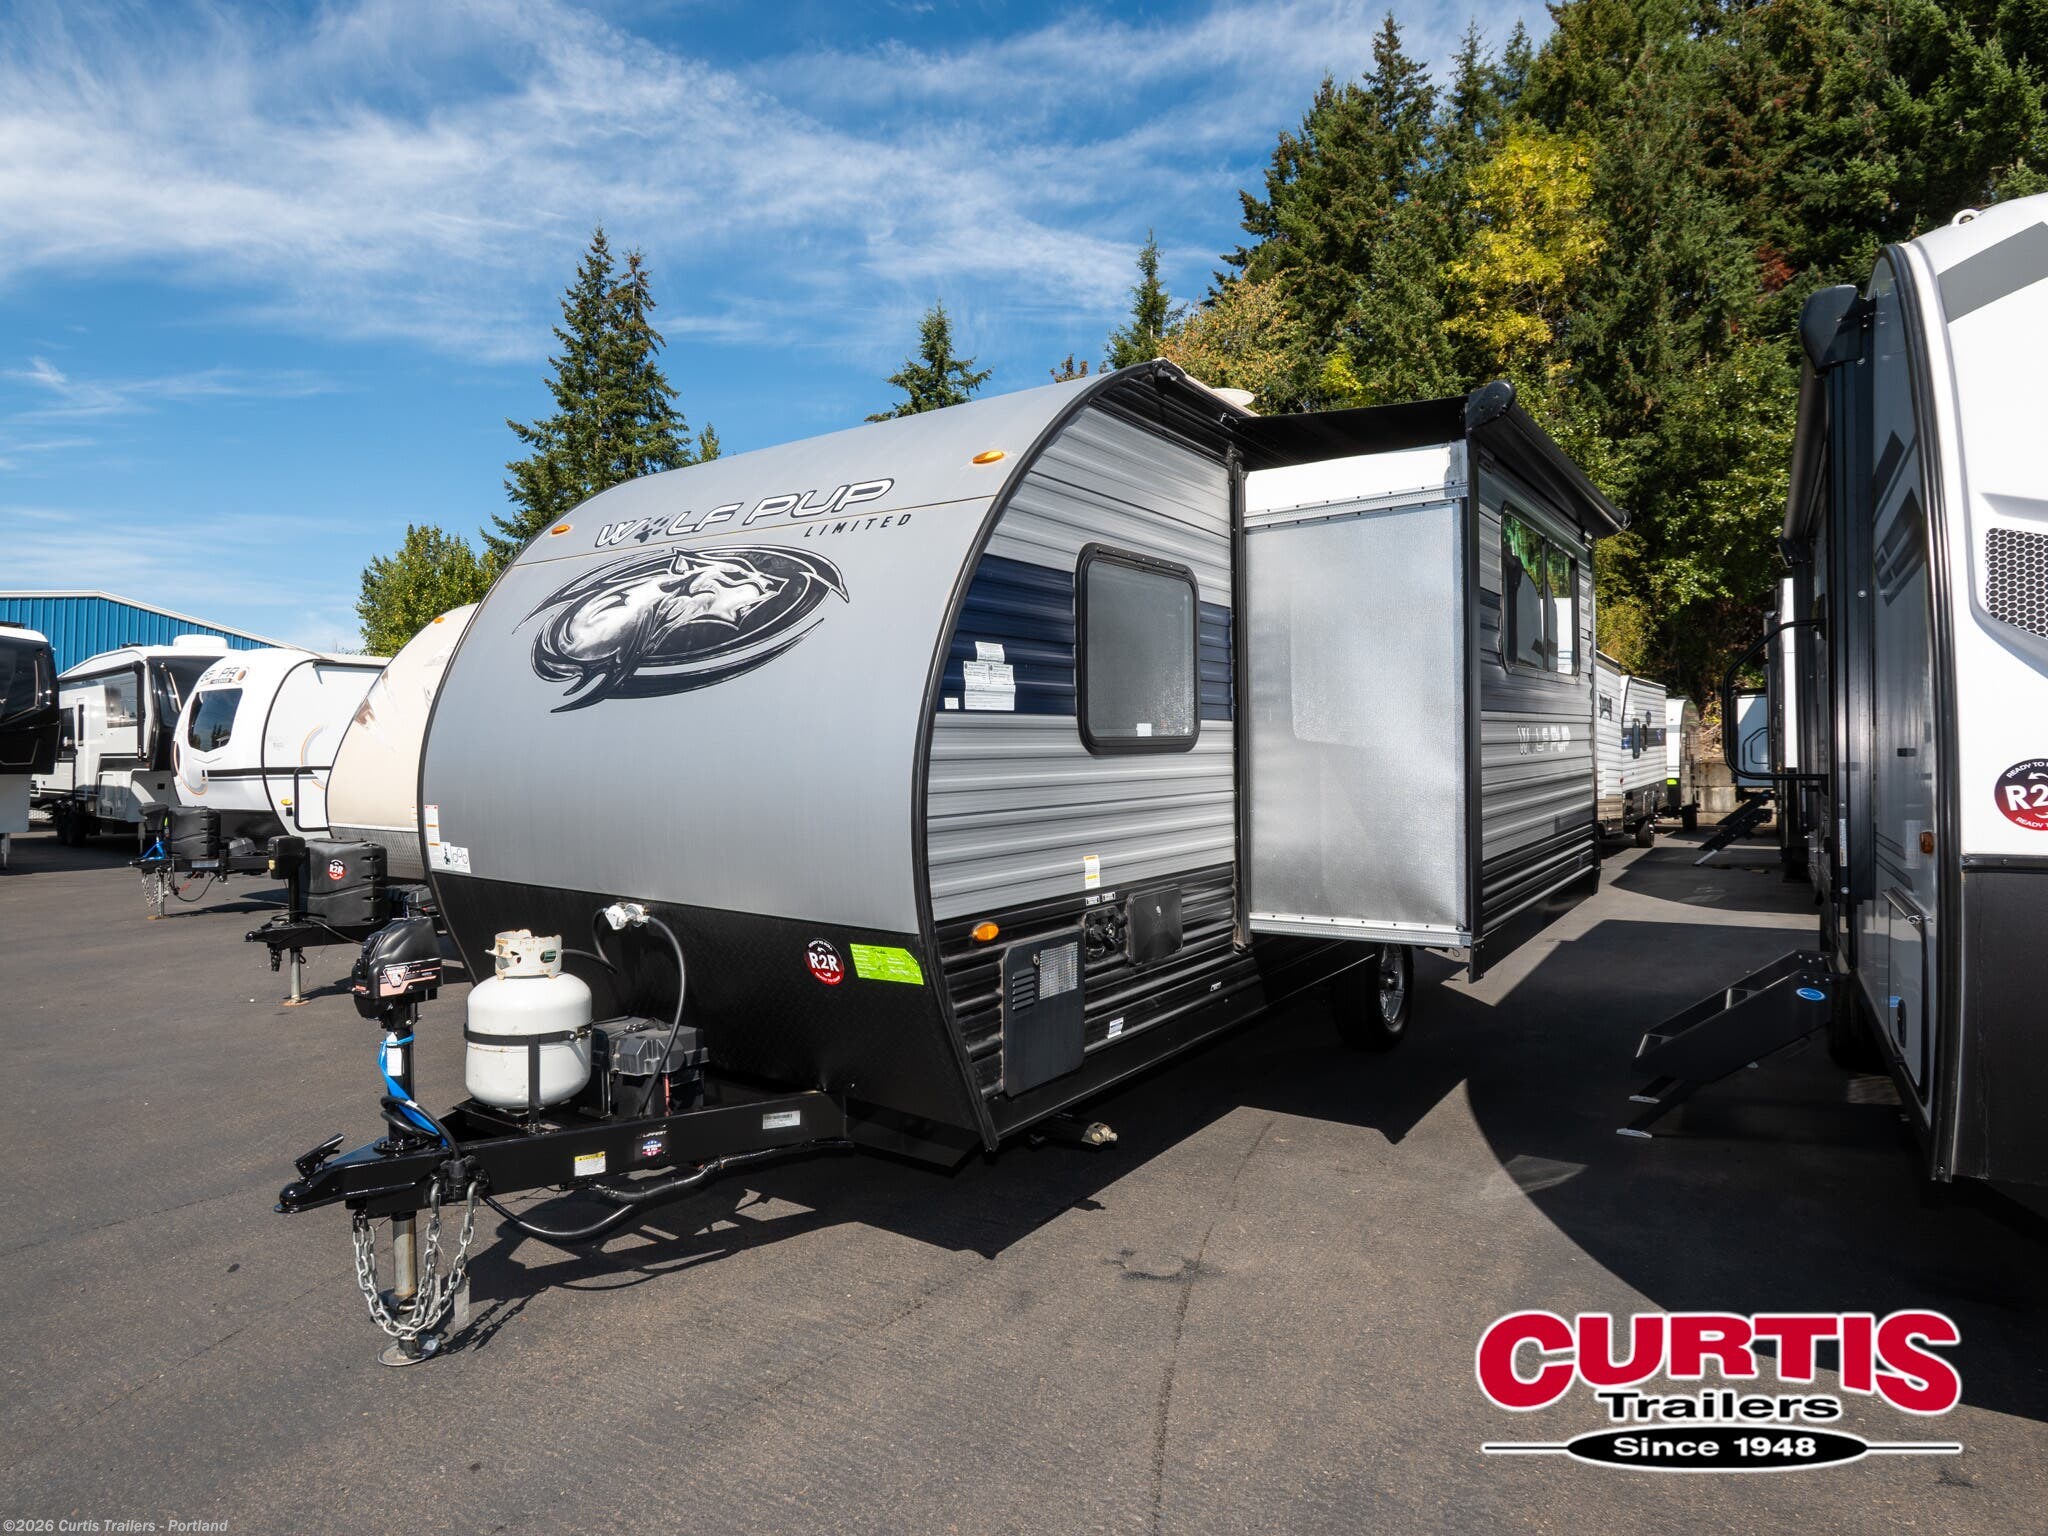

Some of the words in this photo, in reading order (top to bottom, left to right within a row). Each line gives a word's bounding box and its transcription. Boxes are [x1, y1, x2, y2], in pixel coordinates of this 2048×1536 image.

[746, 478, 895, 527] PUP
[803, 513, 912, 538] LIMITED
[2006, 762, 2031, 778] READY
[2015, 816, 2044, 828] READY
[808, 952, 840, 972] R2R
